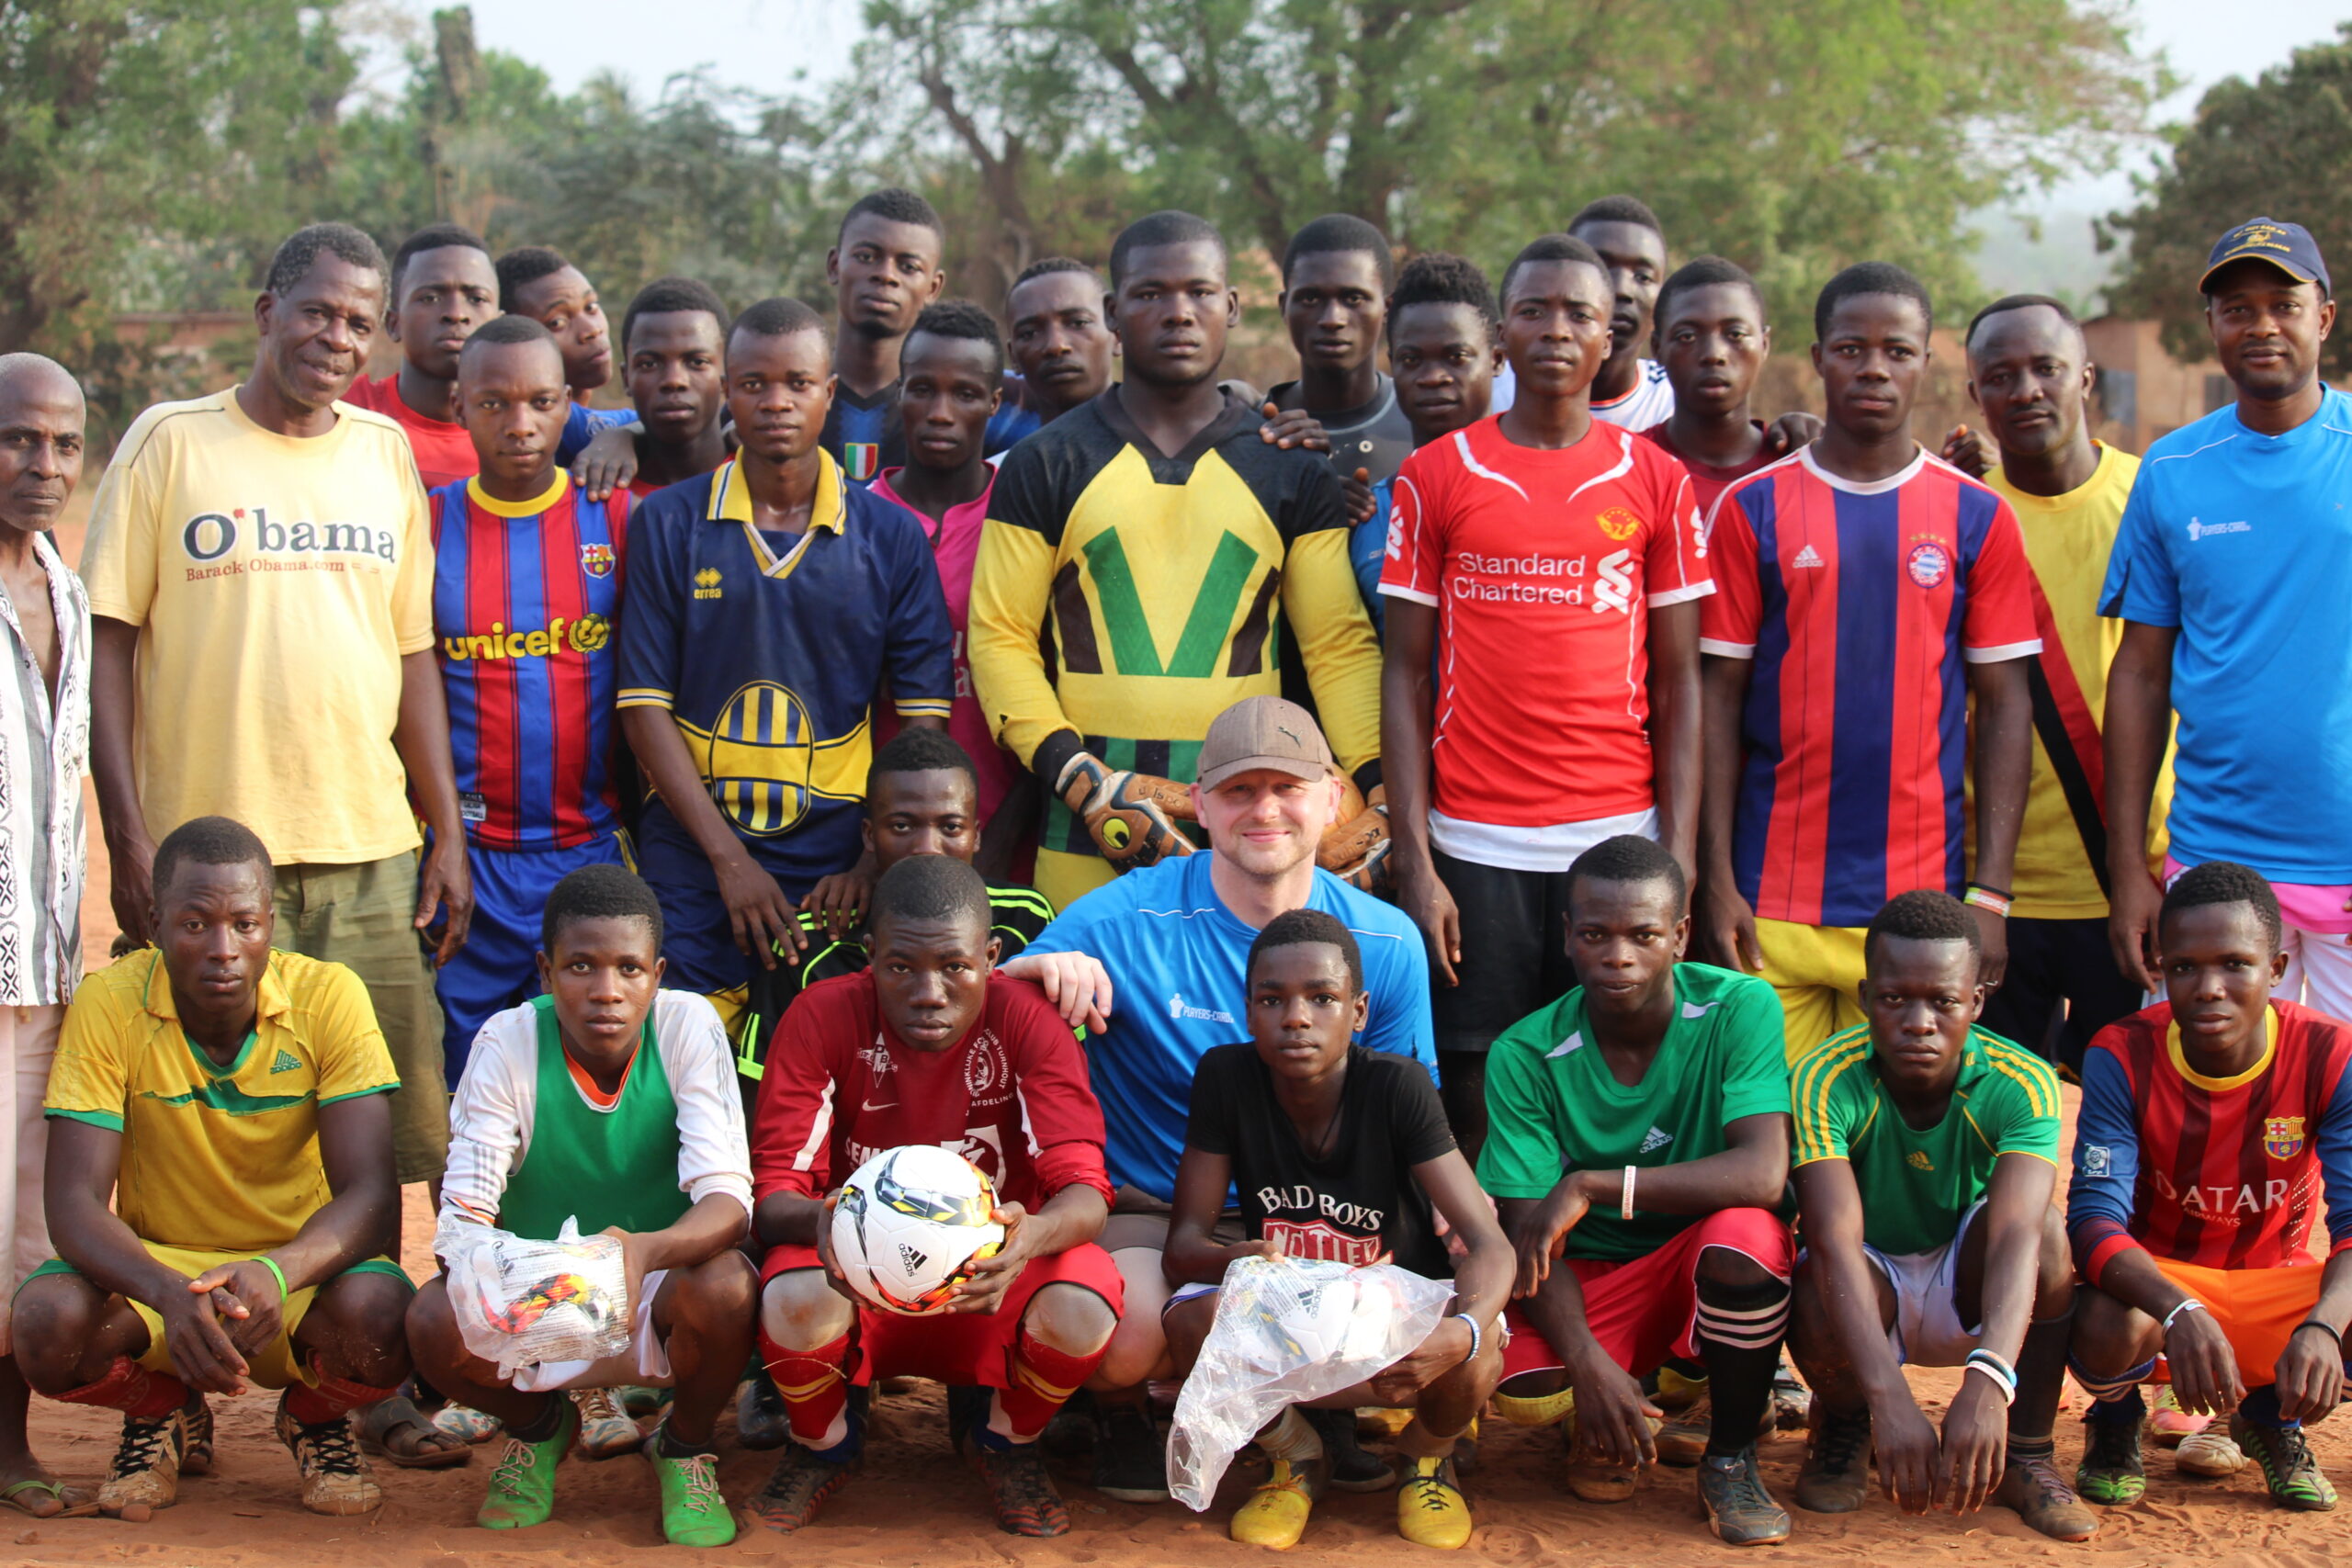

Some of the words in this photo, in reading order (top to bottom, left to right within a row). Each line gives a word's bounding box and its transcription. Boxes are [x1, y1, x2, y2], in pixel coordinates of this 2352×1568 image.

[186, 561, 243, 581] Barack
[1458, 552, 1586, 577] Standard
[1453, 577, 1583, 605] Chartered
[445, 617, 564, 660] unicef
[996, 1045, 1009, 1089] TURNHOUT
[1257, 1185, 1315, 1214] BAD
[1318, 1193, 1385, 1231] BOYS
[899, 1243, 915, 1277] adidas
